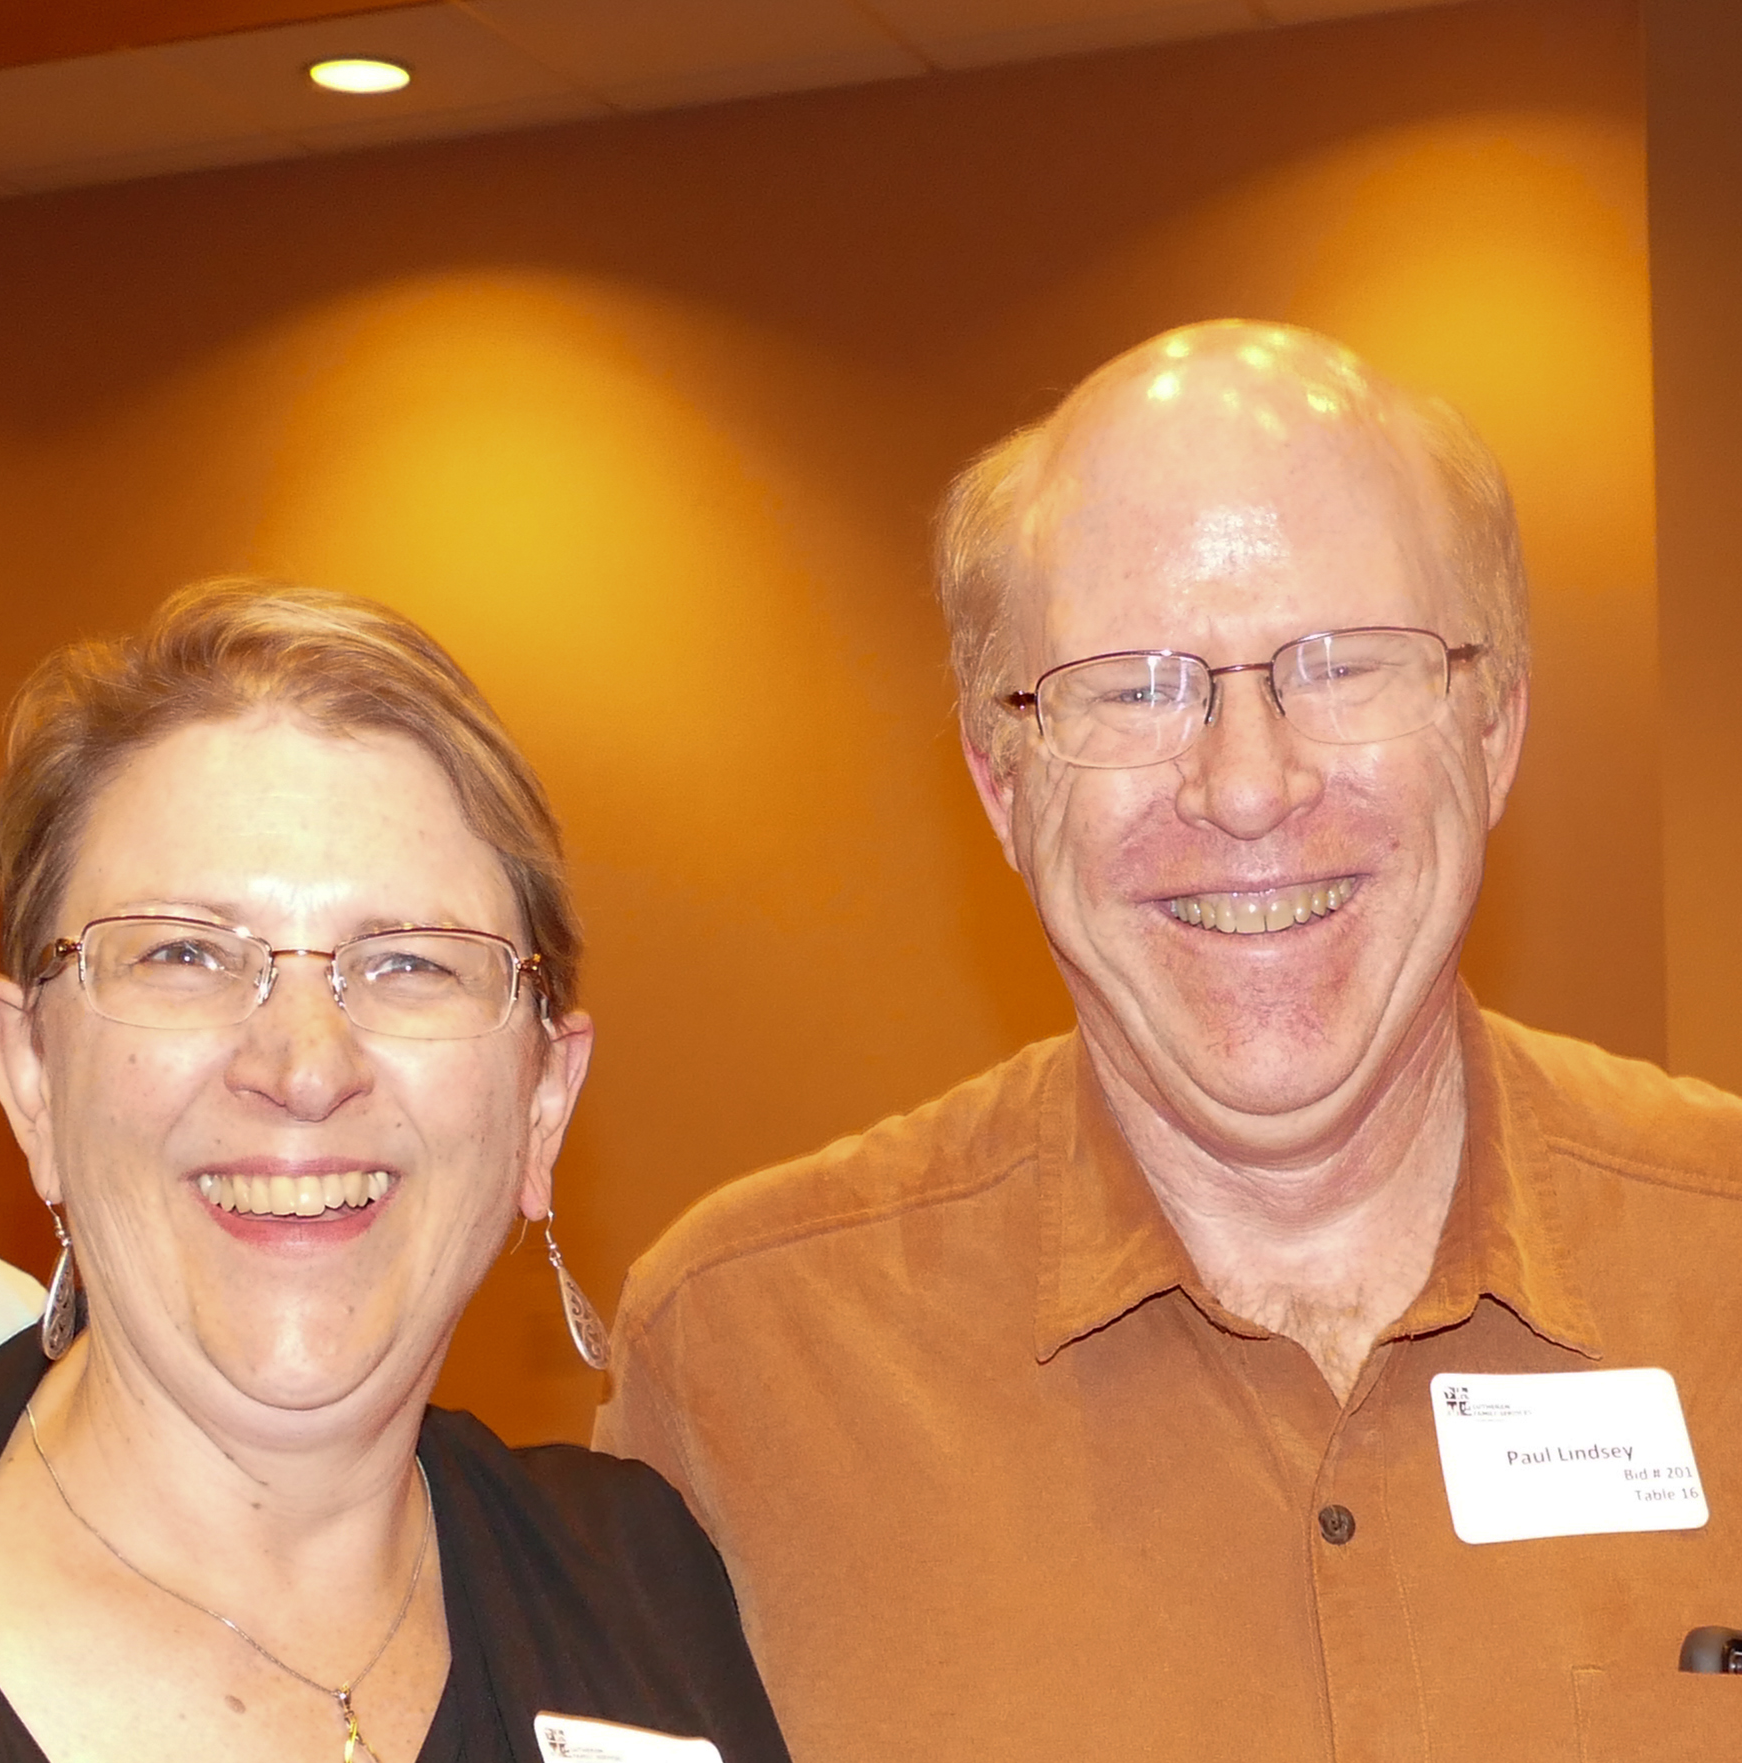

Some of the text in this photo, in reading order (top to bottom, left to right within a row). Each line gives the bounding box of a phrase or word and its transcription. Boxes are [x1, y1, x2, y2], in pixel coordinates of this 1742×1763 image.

[1506, 1444, 1633, 1465] Paul Lindsey
[1623, 1466, 1693, 1481] Bid # 201
[1634, 1487, 1699, 1502] Table 16
